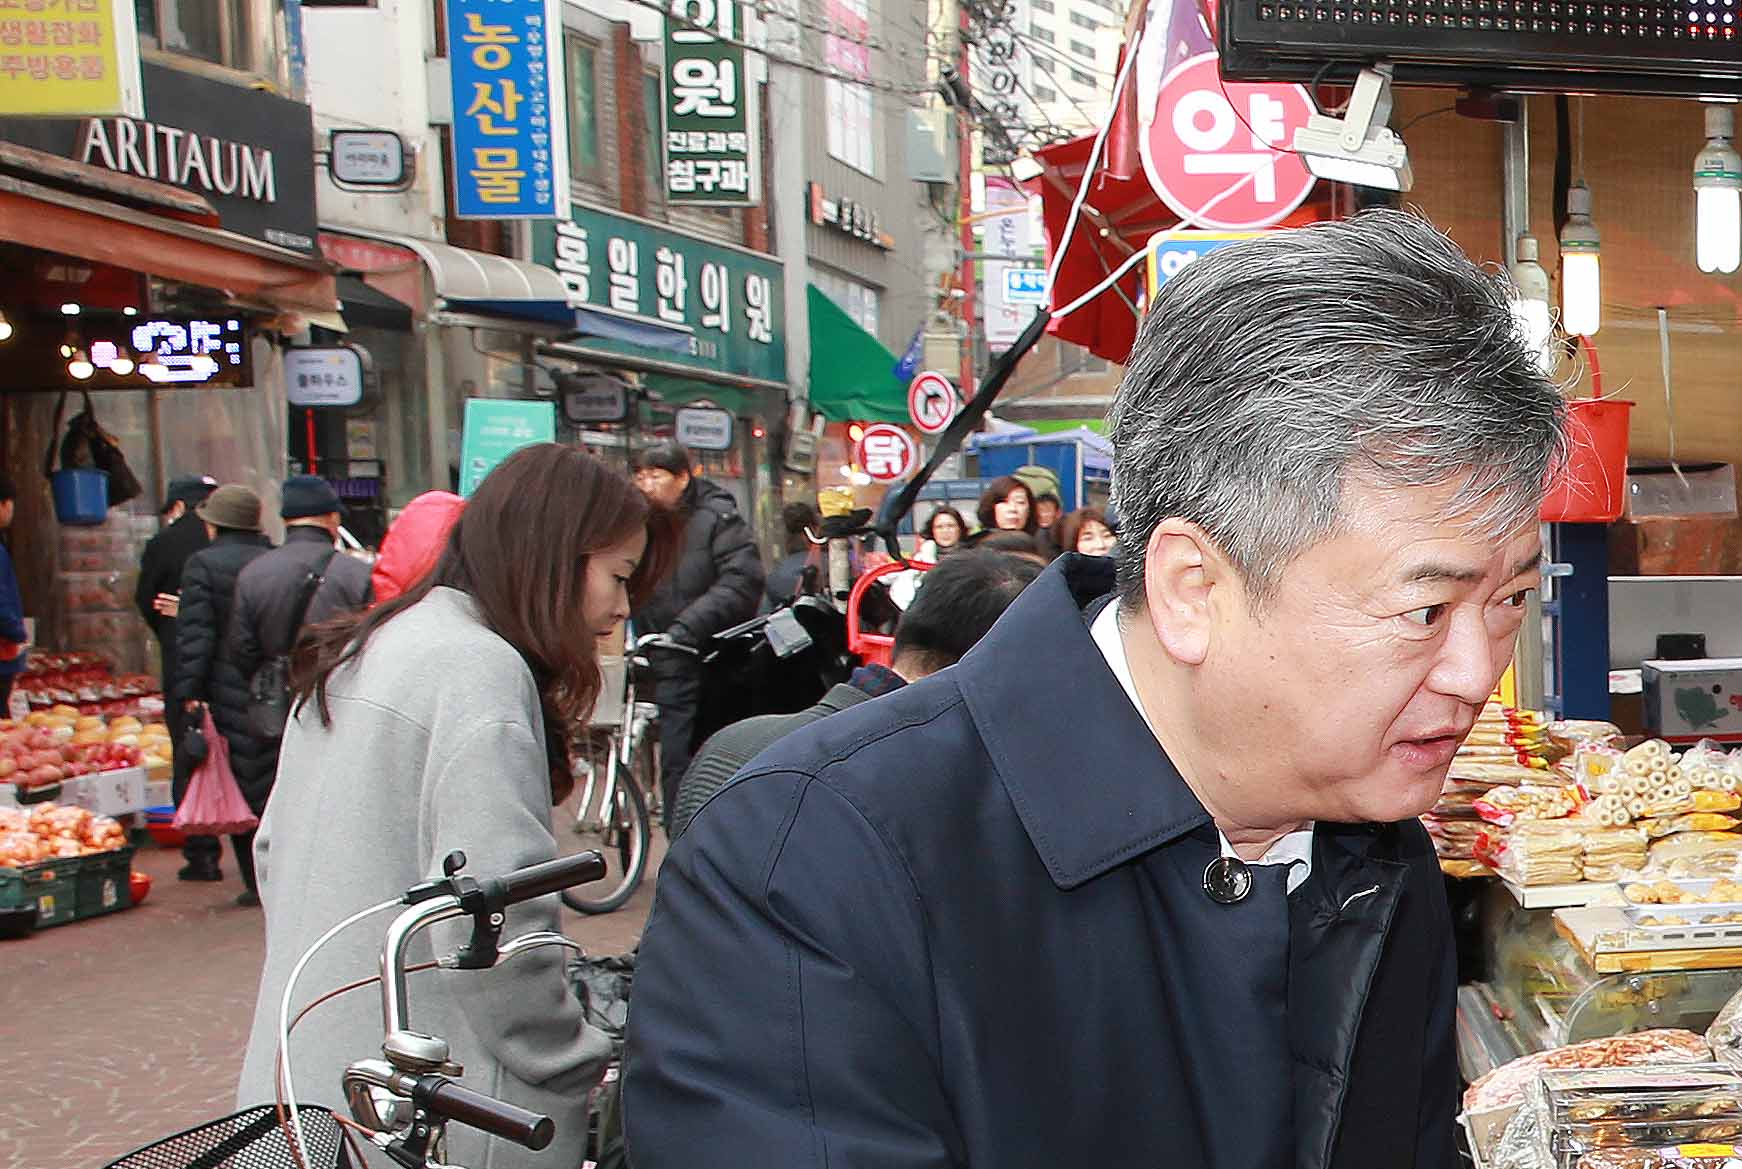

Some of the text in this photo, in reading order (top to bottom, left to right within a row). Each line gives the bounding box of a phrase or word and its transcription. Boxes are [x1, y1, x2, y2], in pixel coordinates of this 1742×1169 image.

[82, 117, 277, 203] ARITAUM
[463, 13, 526, 204] 농산물
[1172, 87, 1285, 204] 약
[668, 159, 749, 193] 침구과
[555, 220, 774, 345] 홍일한의원
